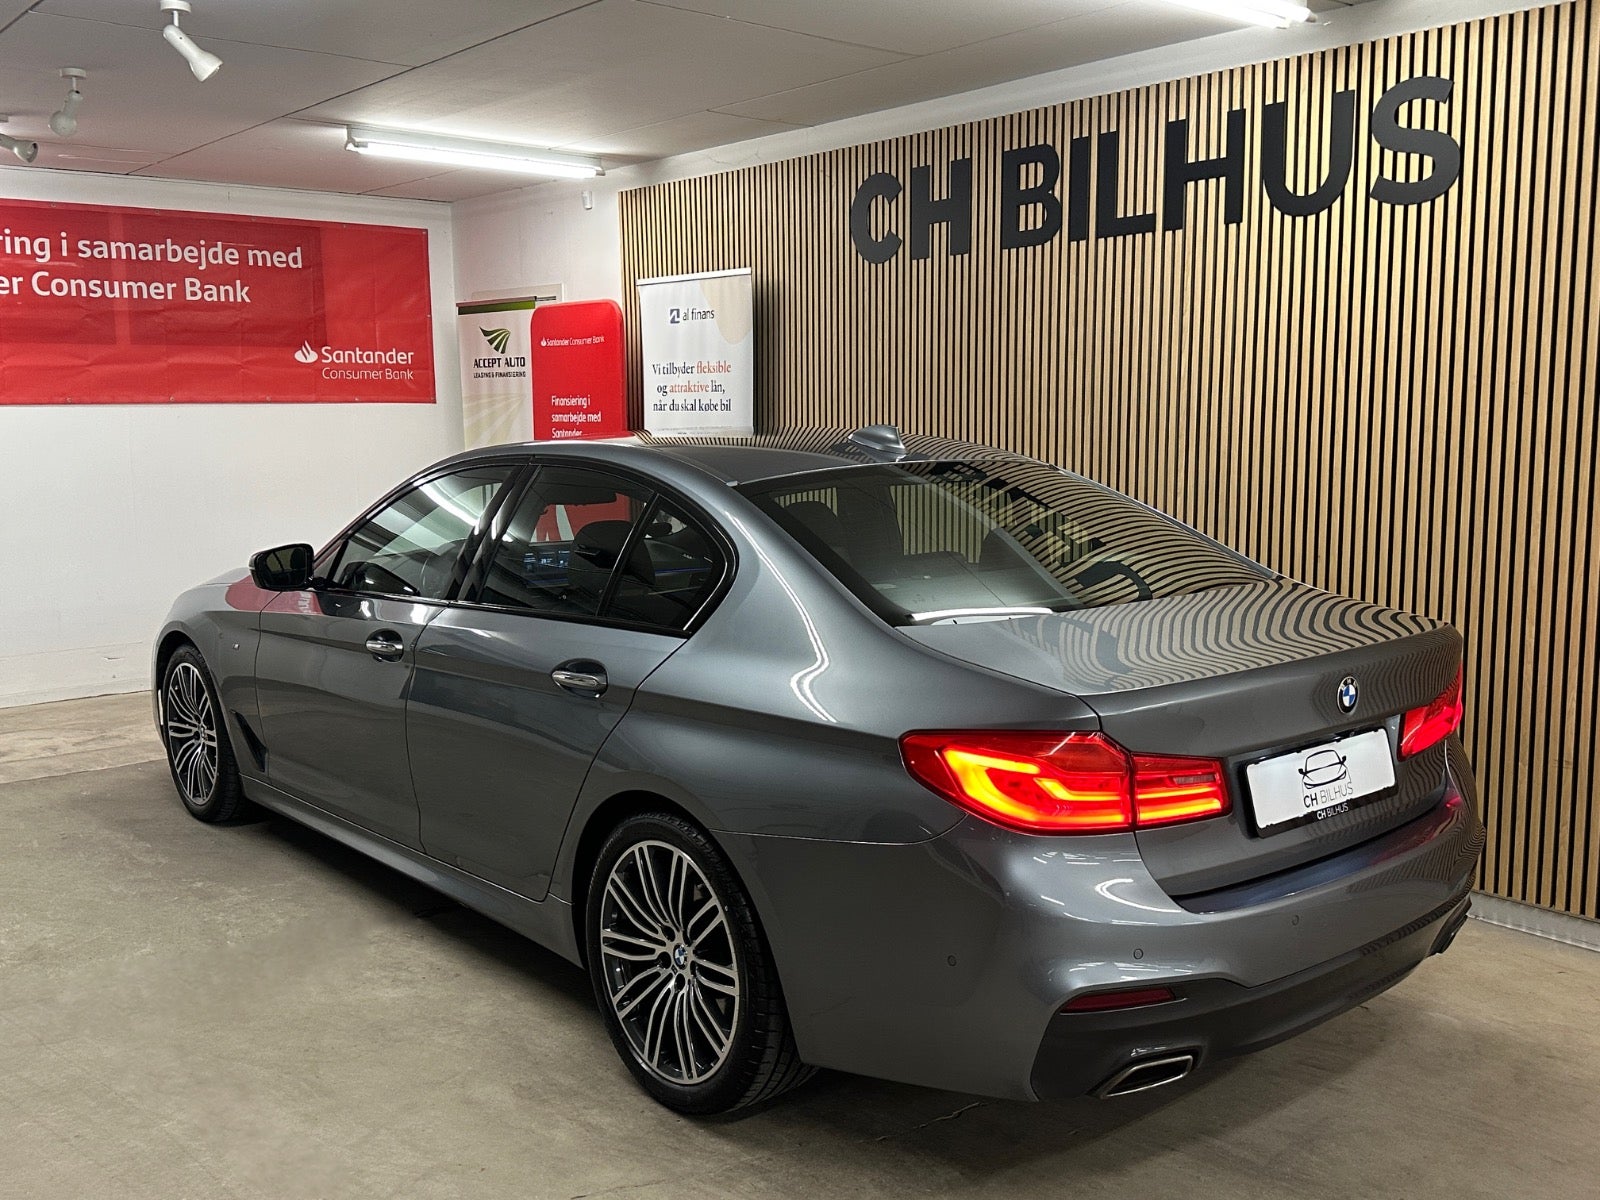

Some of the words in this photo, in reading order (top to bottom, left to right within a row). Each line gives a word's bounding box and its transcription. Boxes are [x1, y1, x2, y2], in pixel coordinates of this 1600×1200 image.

[850, 157, 971, 265] CH
[1002, 75, 1461, 251] BILHUS
[0, 228, 51, 263] ing
[60, 231, 68, 257] i
[77, 238, 240, 270] samarbejde
[247, 246, 303, 269] med
[31, 270, 177, 302] Consumer
[184, 277, 251, 303] Bank
[682, 308, 690, 321] al
[691, 307, 715, 320] finans
[321, 346, 415, 365] Santander
[473, 357, 502, 368] ACCEPT
[504, 356, 526, 367] AUTO
[321, 367, 384, 380] Consumer
[385, 368, 414, 380] Bank
[652, 363, 661, 375] Vi
[662, 361, 695, 378] tilbyder
[696, 360, 731, 374] fleksible
[657, 384, 668, 397] og
[669, 380, 709, 393] attraktive
[551, 395, 587, 409] Finansiering
[653, 400, 667, 412] når
[669, 399, 680, 412] du
[680, 399, 697, 412] skal
[698, 398, 719, 412] købe
[720, 398, 732, 412] bil
[551, 411, 586, 425] samarbejde
[587, 410, 602, 422] med
[1303, 792, 1318, 808] CH
[1319, 781, 1354, 804] BILHUS
[1316, 809, 1327, 820] CH
[1326, 802, 1349, 817] BILHUS
